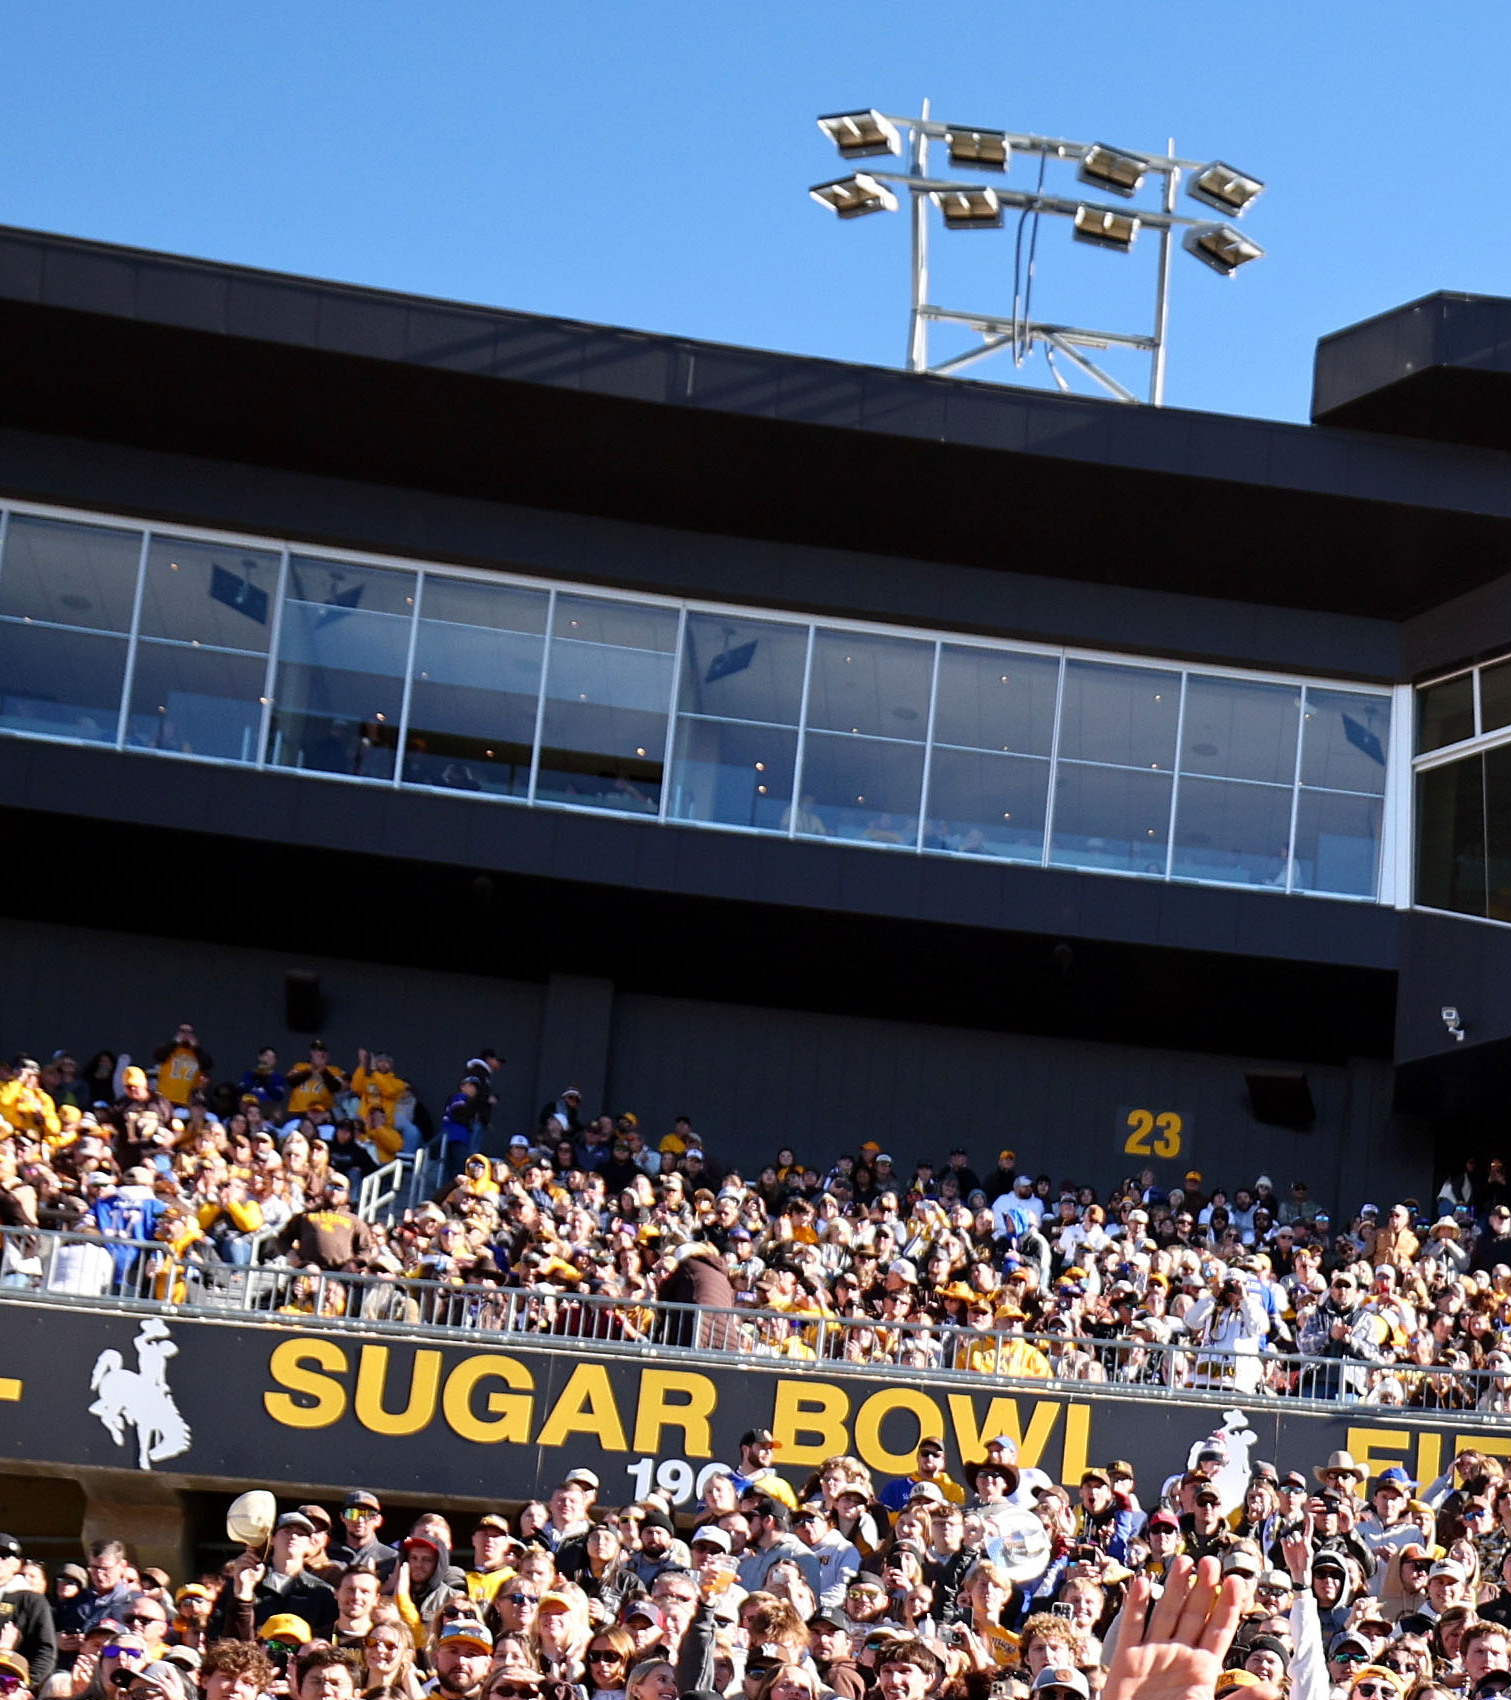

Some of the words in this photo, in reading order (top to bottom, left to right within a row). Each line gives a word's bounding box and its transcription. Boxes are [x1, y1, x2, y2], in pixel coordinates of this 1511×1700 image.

[1123, 1108, 1182, 1158] 23
[264, 1337, 717, 1459] SUGAR
[772, 1380, 1106, 1487] BOWL
